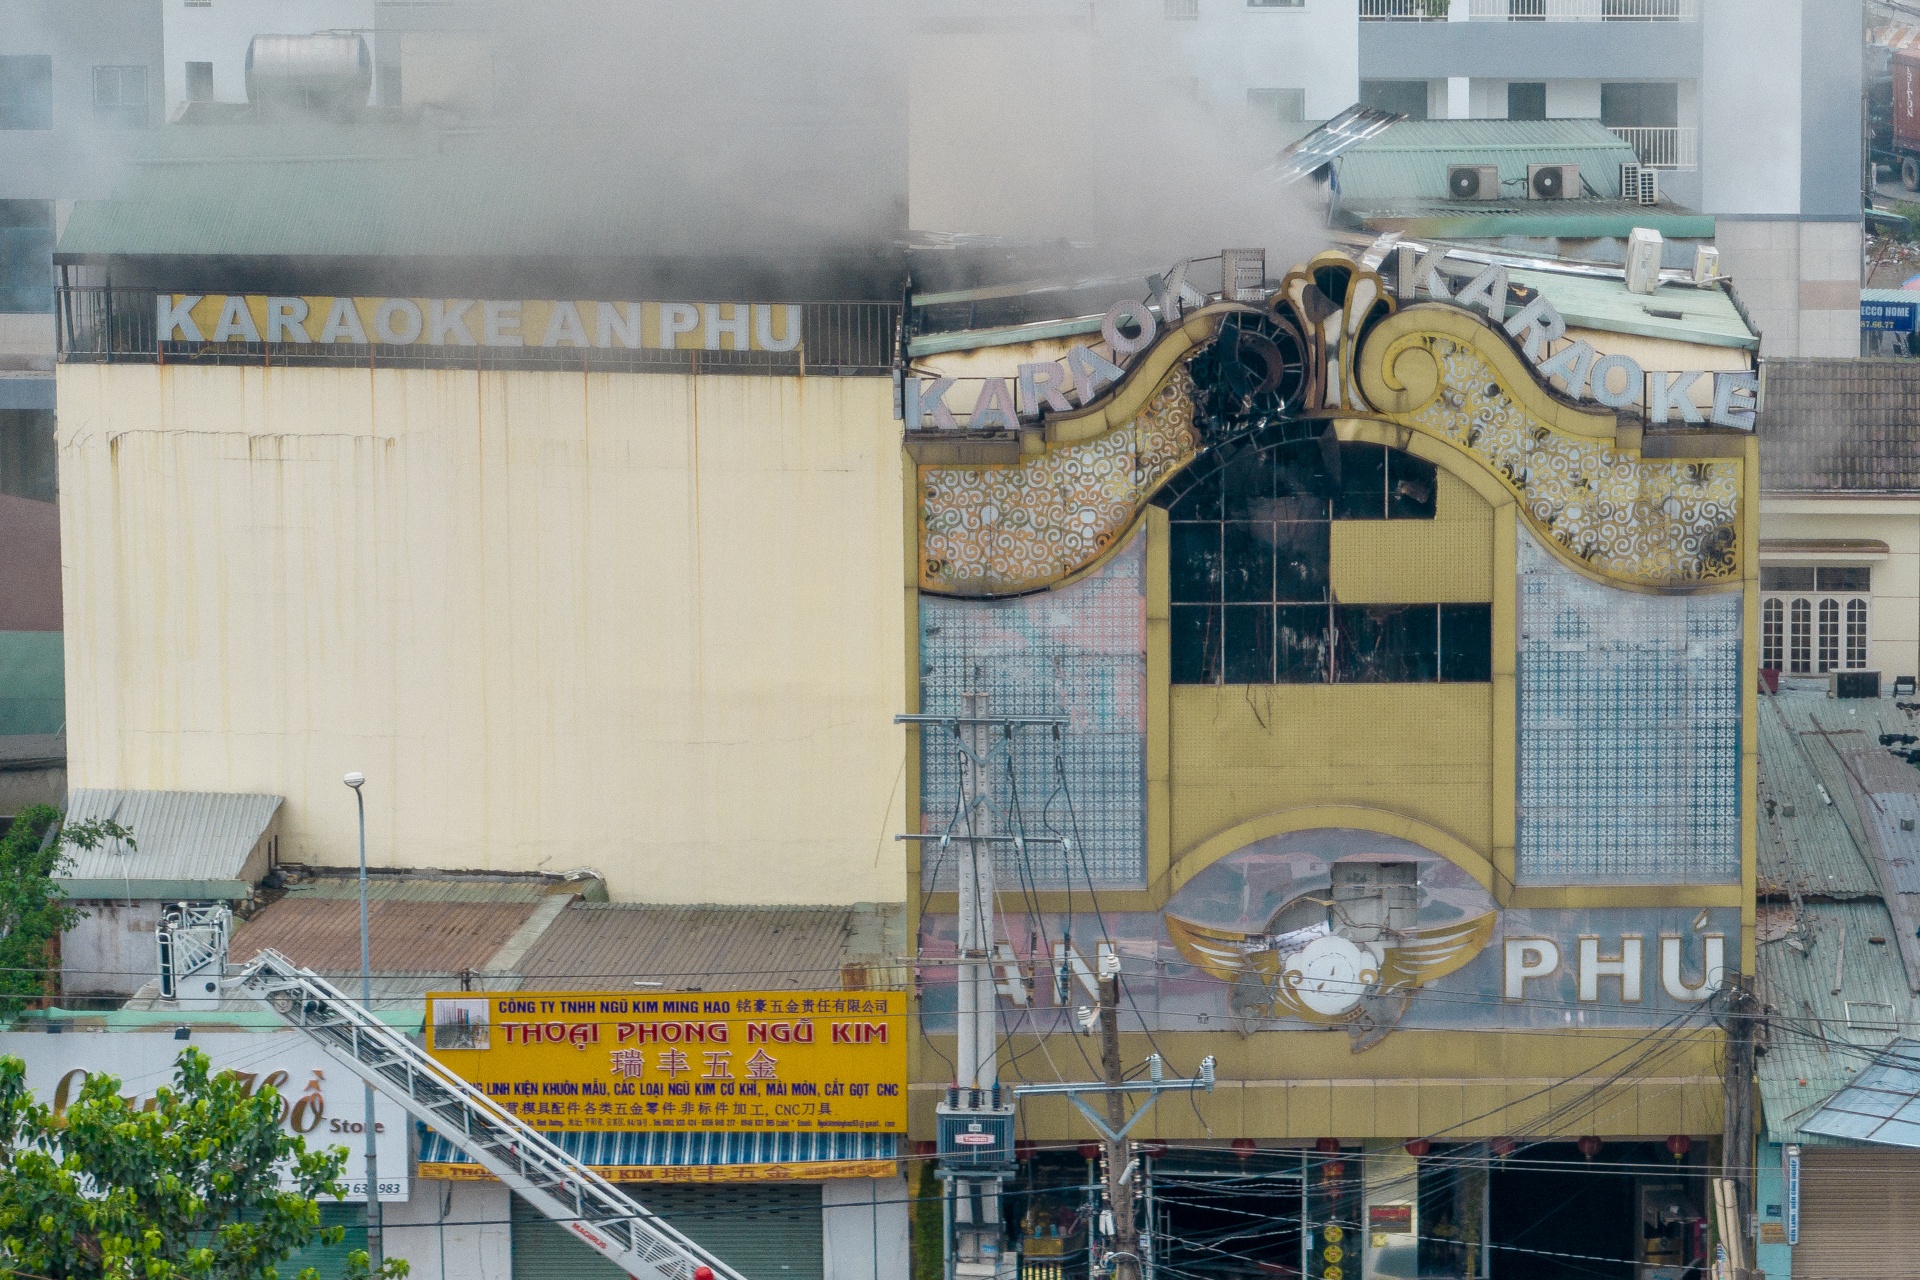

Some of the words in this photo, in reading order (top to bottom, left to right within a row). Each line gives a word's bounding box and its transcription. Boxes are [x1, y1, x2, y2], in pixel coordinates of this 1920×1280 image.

[156, 295, 524, 348] KARAOKE
[542, 300, 643, 348] AN
[659, 302, 802, 351] PHU
[1885, 306, 1910, 317] HOME
[904, 247, 1266, 430] KARAOKE
[1398, 246, 1760, 431] KARAOKE
[1502, 908, 1725, 1004] PHÚ
[498, 998, 536, 1014] CÔNG
[540, 1001, 555, 1014] TY
[560, 1001, 596, 1014] TNHH
[600, 998, 629, 1014] NGŨ
[632, 1001, 659, 1014] KIM
[662, 1001, 699, 1014] MING
[703, 1001, 731, 1014] HAO
[499, 1021, 600, 1051] THOẠI
[616, 1021, 729, 1045] PHONG
[746, 1017, 815, 1044] NGŨ
[830, 1021, 889, 1044] KIM
[609, 1047, 779, 1081] 瑞丰五金
[486, 1082, 510, 1096] LINH
[514, 1080, 539, 1098] KIỆN
[542, 1080, 579, 1096] KHUÔN
[613, 1080, 636, 1096] CÁC
[639, 1082, 664, 1098] LOẠI
[668, 1080, 691, 1096] NGŨ
[694, 1082, 716, 1096] KIM
[849, 1082, 870, 1099] GỌT
[876, 1083, 900, 1097] CNC
[329, 1117, 386, 1134] Stoe
[618, 1168, 654, 1180] KIM
[378, 1183, 401, 1194] 983
